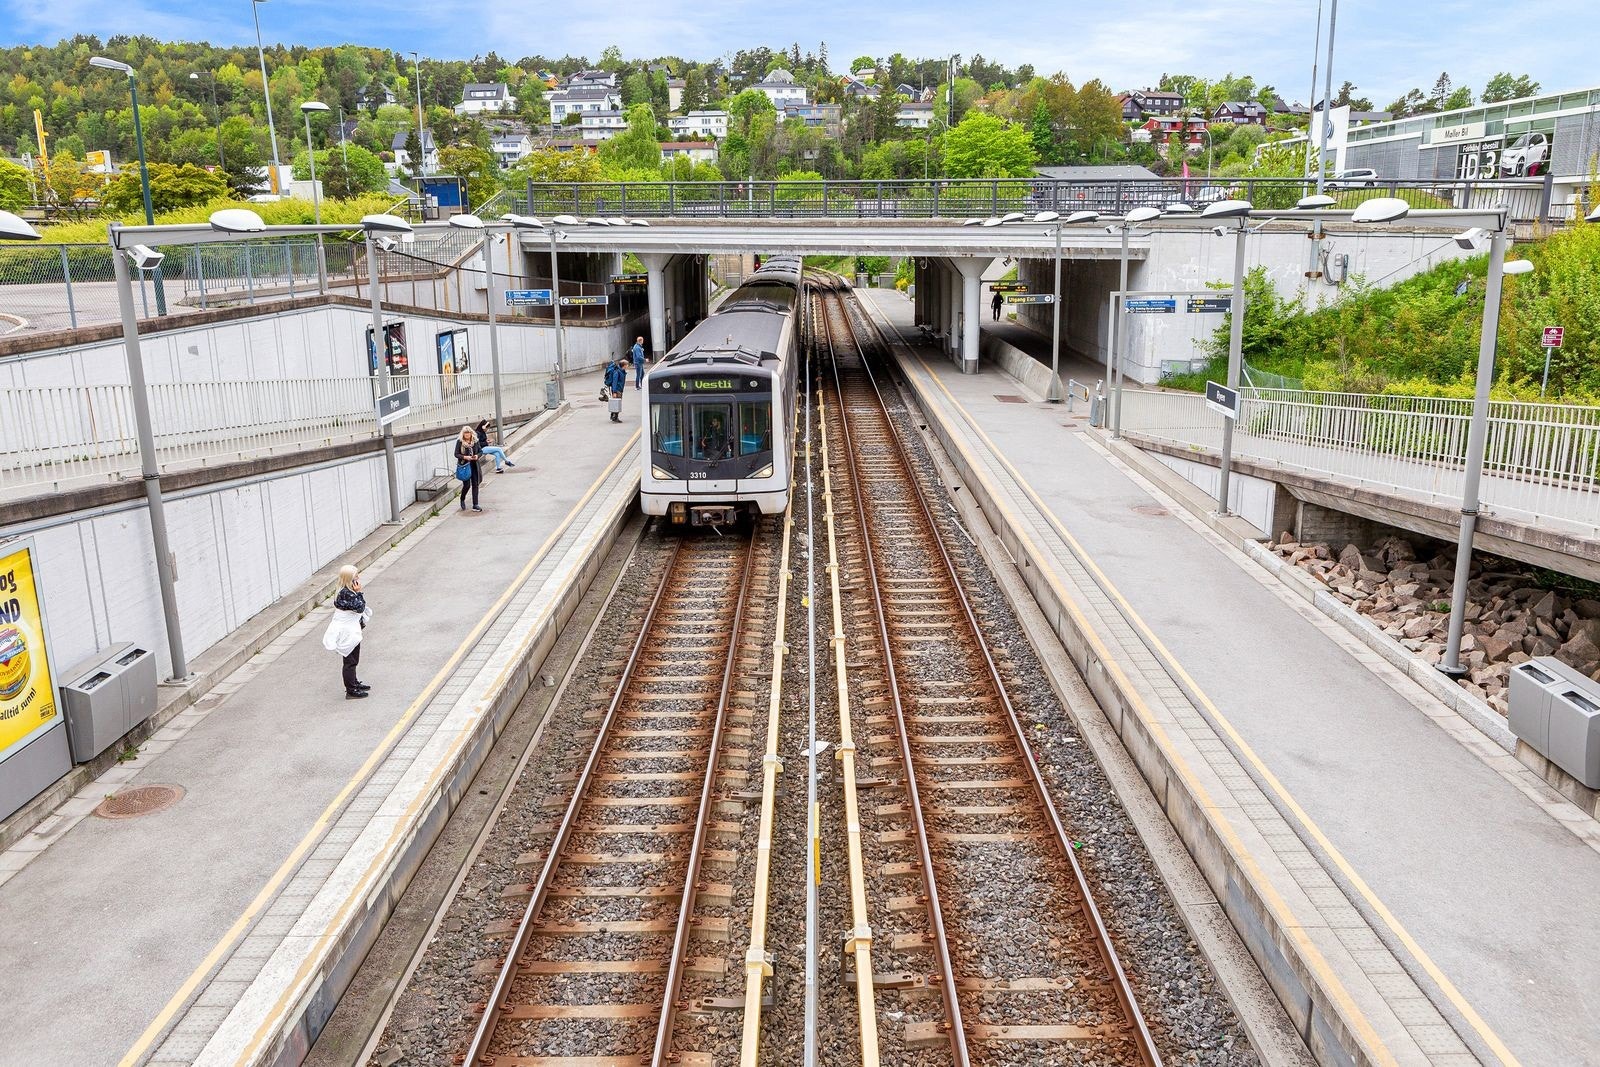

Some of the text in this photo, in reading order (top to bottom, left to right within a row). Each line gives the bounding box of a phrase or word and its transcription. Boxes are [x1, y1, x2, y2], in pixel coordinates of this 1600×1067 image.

[1444, 129, 1461, 139] Møller
[1460, 151, 1496, 180] ID.3
[681, 380, 732, 390] 4 Vestli
[20, 687, 37, 711] sunn!
